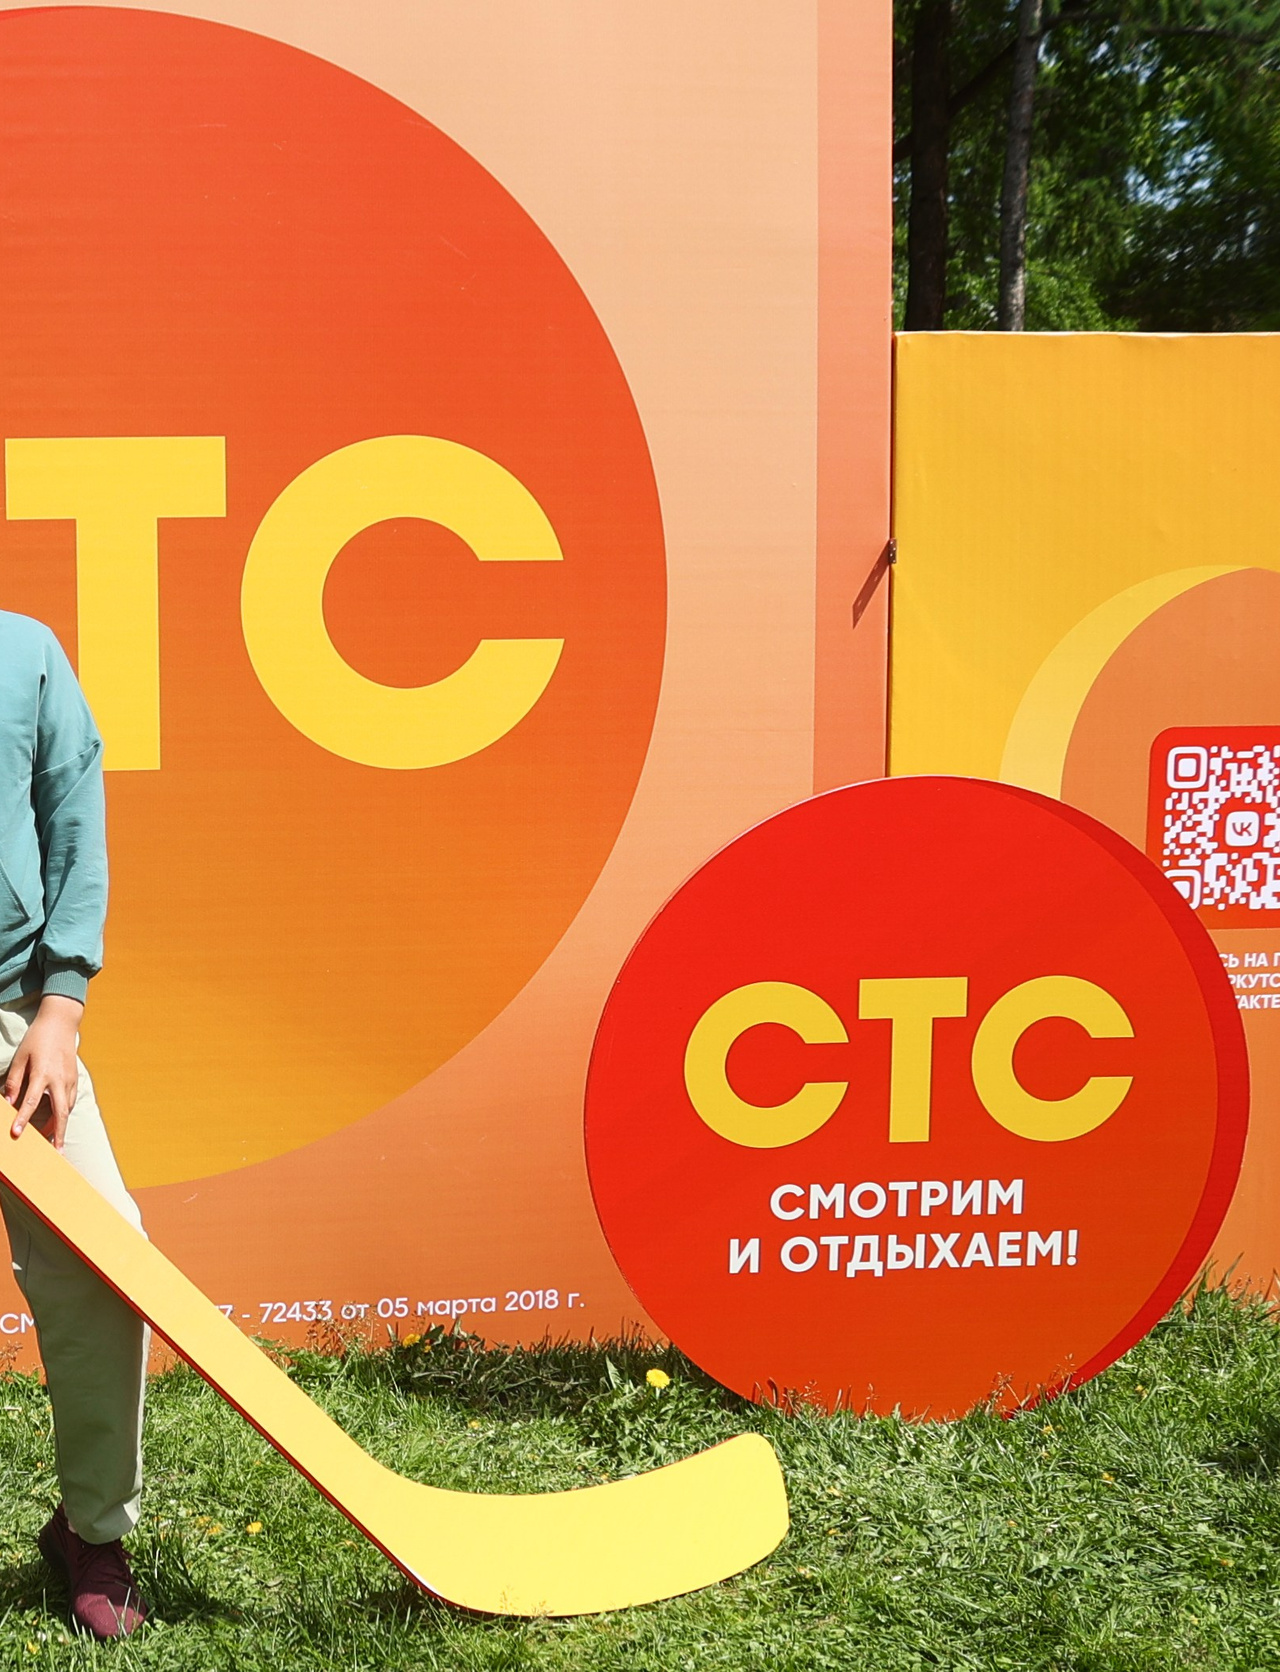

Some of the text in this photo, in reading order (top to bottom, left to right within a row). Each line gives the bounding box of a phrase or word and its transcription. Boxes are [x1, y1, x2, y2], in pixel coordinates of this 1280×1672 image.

[1244, 952, 1269, 968] НА
[685, 975, 1135, 1149] СТС
[769, 1179, 1024, 1221] СМОТРИМ
[729, 1230, 1079, 1278] И ОТДЫХАЕМ!
[259, 1300, 333, 1324] 72433
[340, 1303, 370, 1320] от
[376, 1297, 409, 1319] 05
[416, 1296, 497, 1319] марта
[504, 1288, 560, 1312] 2018
[567, 1292, 585, 1308] г.
